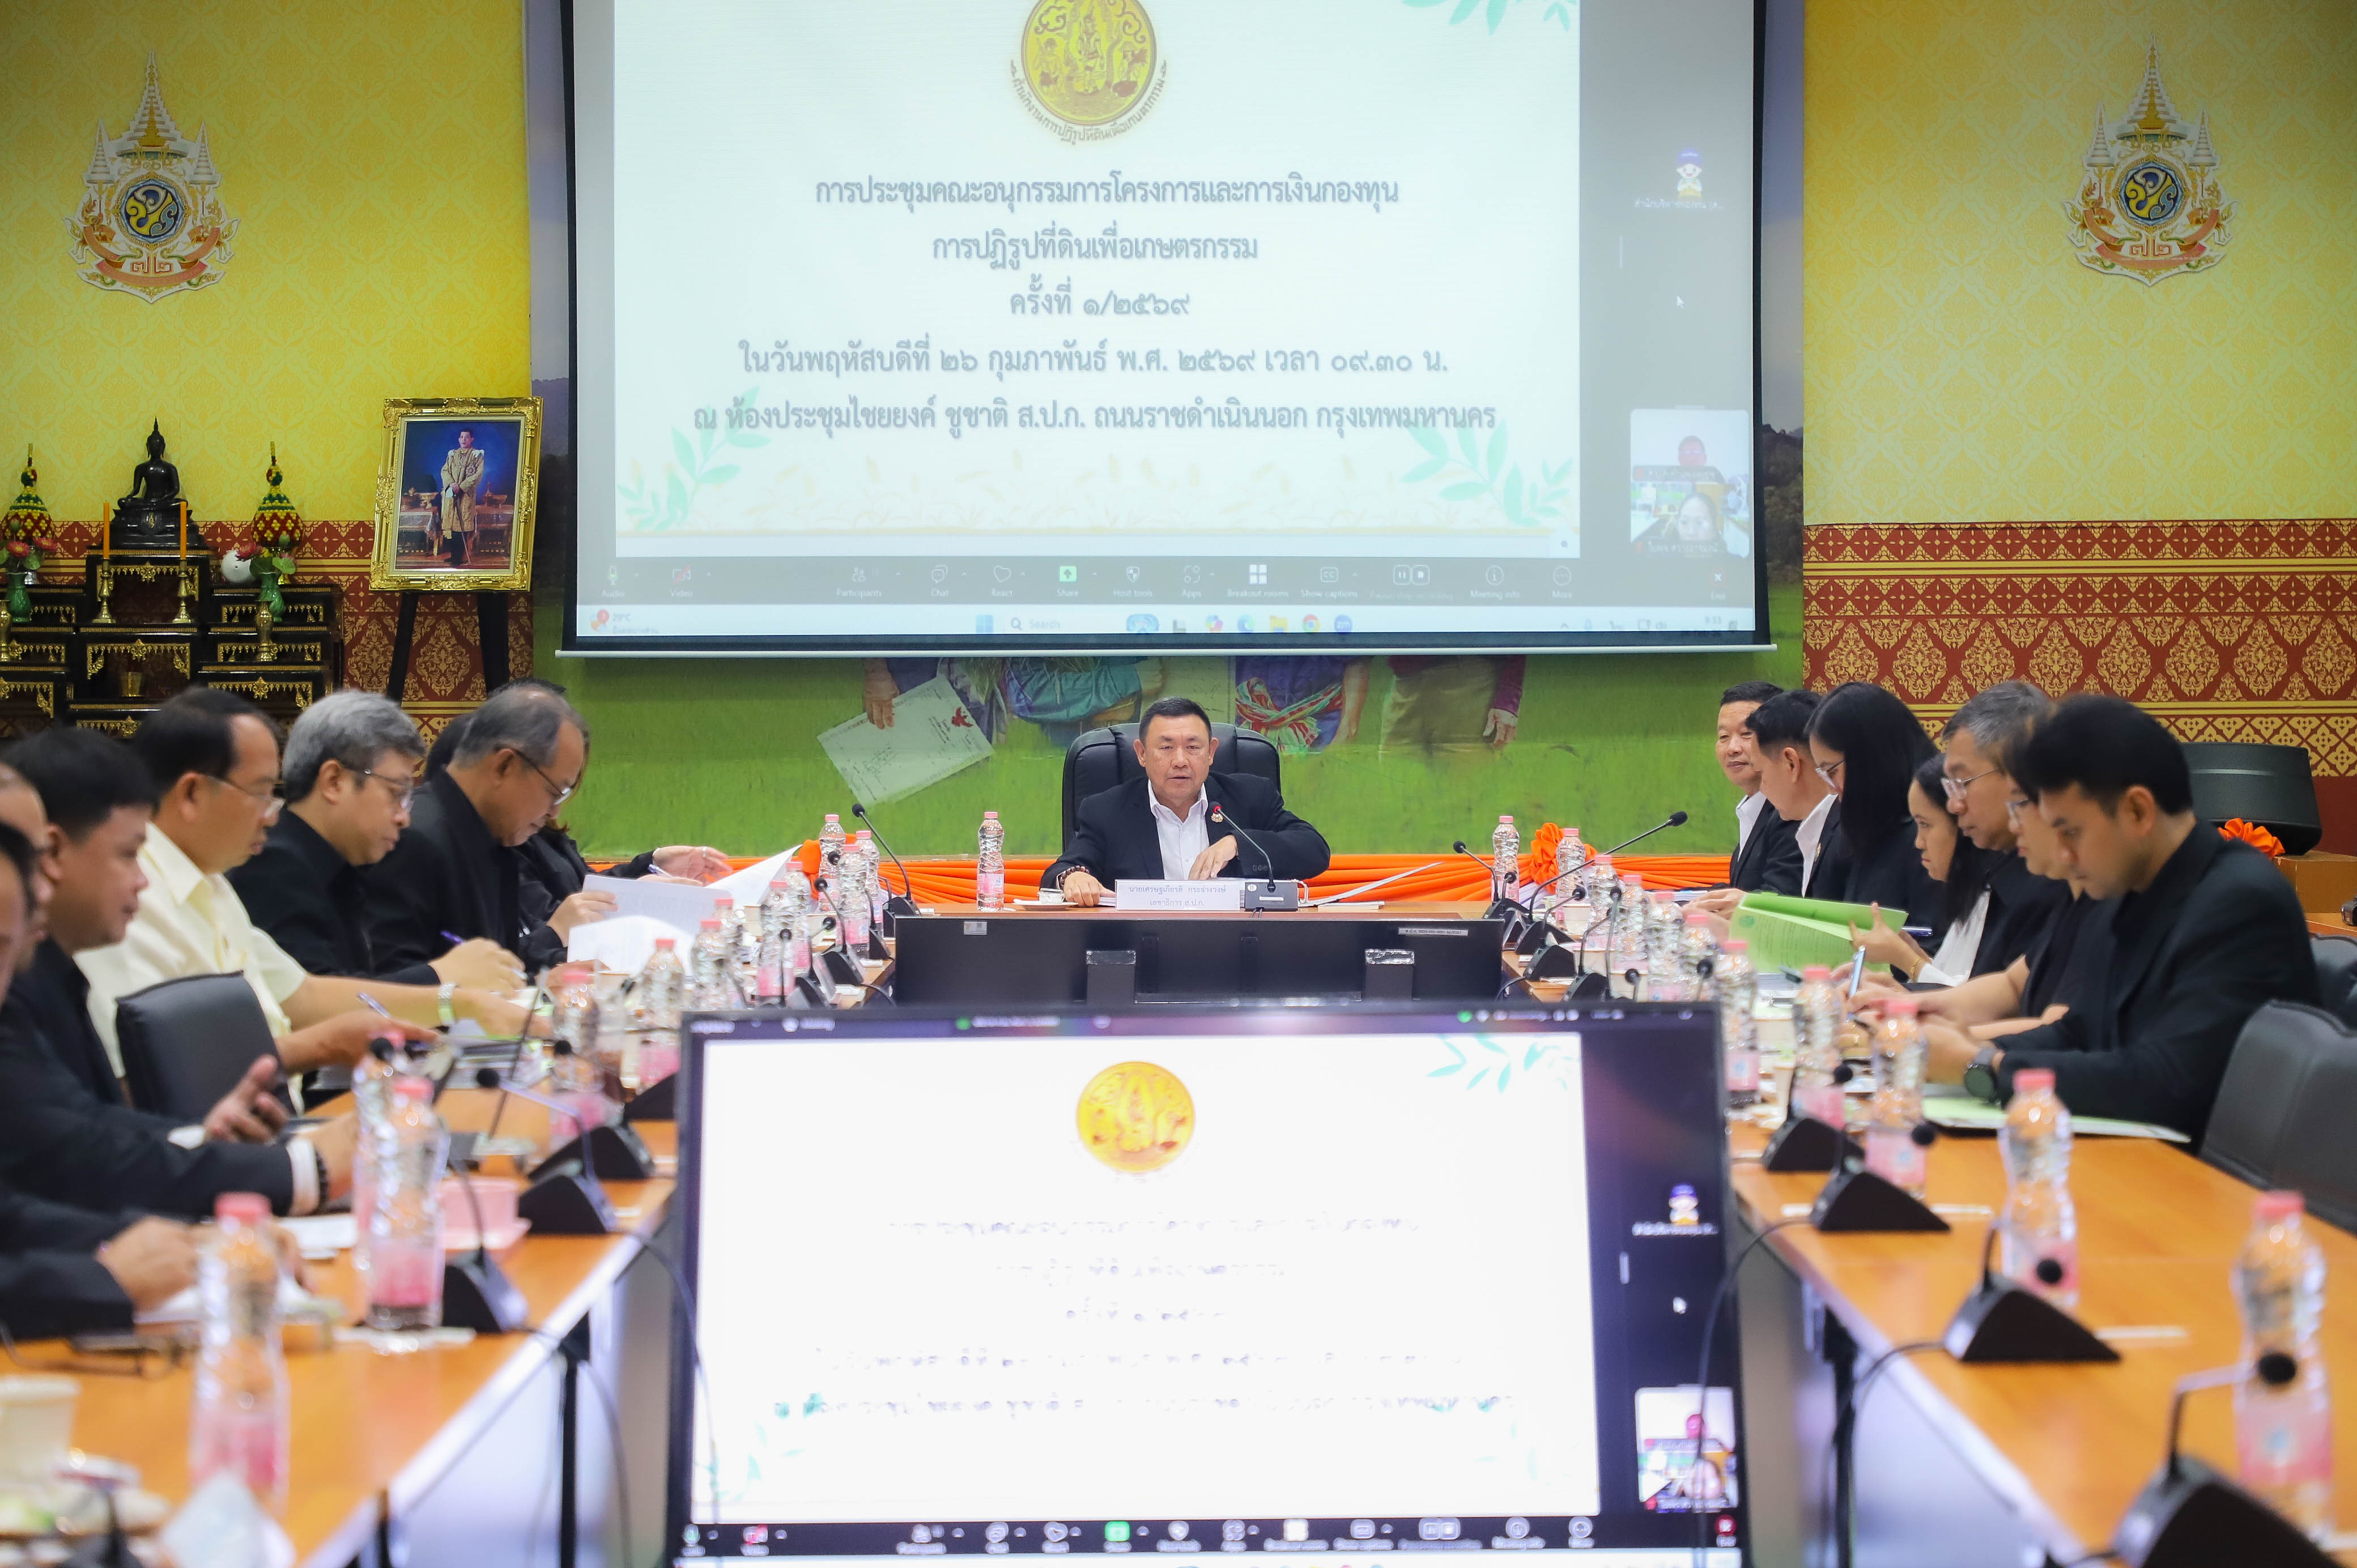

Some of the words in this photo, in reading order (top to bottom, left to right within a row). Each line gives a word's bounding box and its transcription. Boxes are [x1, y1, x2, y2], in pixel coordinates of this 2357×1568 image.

[816, 171, 1399, 213] การประชุมคณะอนุกรรมการโครงการและการเงินกองทุน
[934, 220, 1258, 270] การปฏิรูปที่ดินเพื่อเกษตรกรรม
[1011, 274, 1071, 315] ครั้งที่
[1084, 291, 1190, 316] ๑/๒๕๖๙
[739, 333, 930, 378] ในวันพฤหัสบดีที่
[941, 351, 978, 372] ๒๖
[990, 339, 1108, 381] กุมภาพันธ์
[1117, 350, 1168, 372] พ.ศ.
[1179, 351, 1256, 372] ๒๕๖๙
[1266, 351, 1320, 372] เวลา
[1332, 351, 1413, 372] ๐๙.๓๐
[1424, 352, 1448, 372] น.
[695, 408, 717, 429] ณ
[726, 394, 937, 439] ห้องประชุมไชยยงค์
[946, 398, 1008, 439] ชูชาติ
[1018, 400, 1086, 428] ส.ป.ก.
[1096, 397, 1308, 429] ถนนราชดำเนินนอก
[1317, 407, 1496, 438] กรุงเทพมหานคร
[836, 588, 882, 599] Participants
[931, 588, 949, 597] Chat
[991, 588, 1012, 597] React
[1057, 588, 1079, 597] Share
[1113, 589, 1132, 597] Host
[1133, 589, 1153, 597] tools
[1182, 589, 1202, 599] Apps
[1227, 589, 1261, 598] Breakout
[1301, 589, 1321, 598] Show
[1324, 589, 1358, 599] captions
[1470, 590, 1503, 600] Meeting
[1504, 590, 1520, 599] info
[1551, 590, 1573, 599] More
[1029, 619, 1061, 629] Search
[1129, 884, 1183, 894] นายเศรษฐเกียรติ
[1150, 898, 1182, 906] เลขาธิการ
